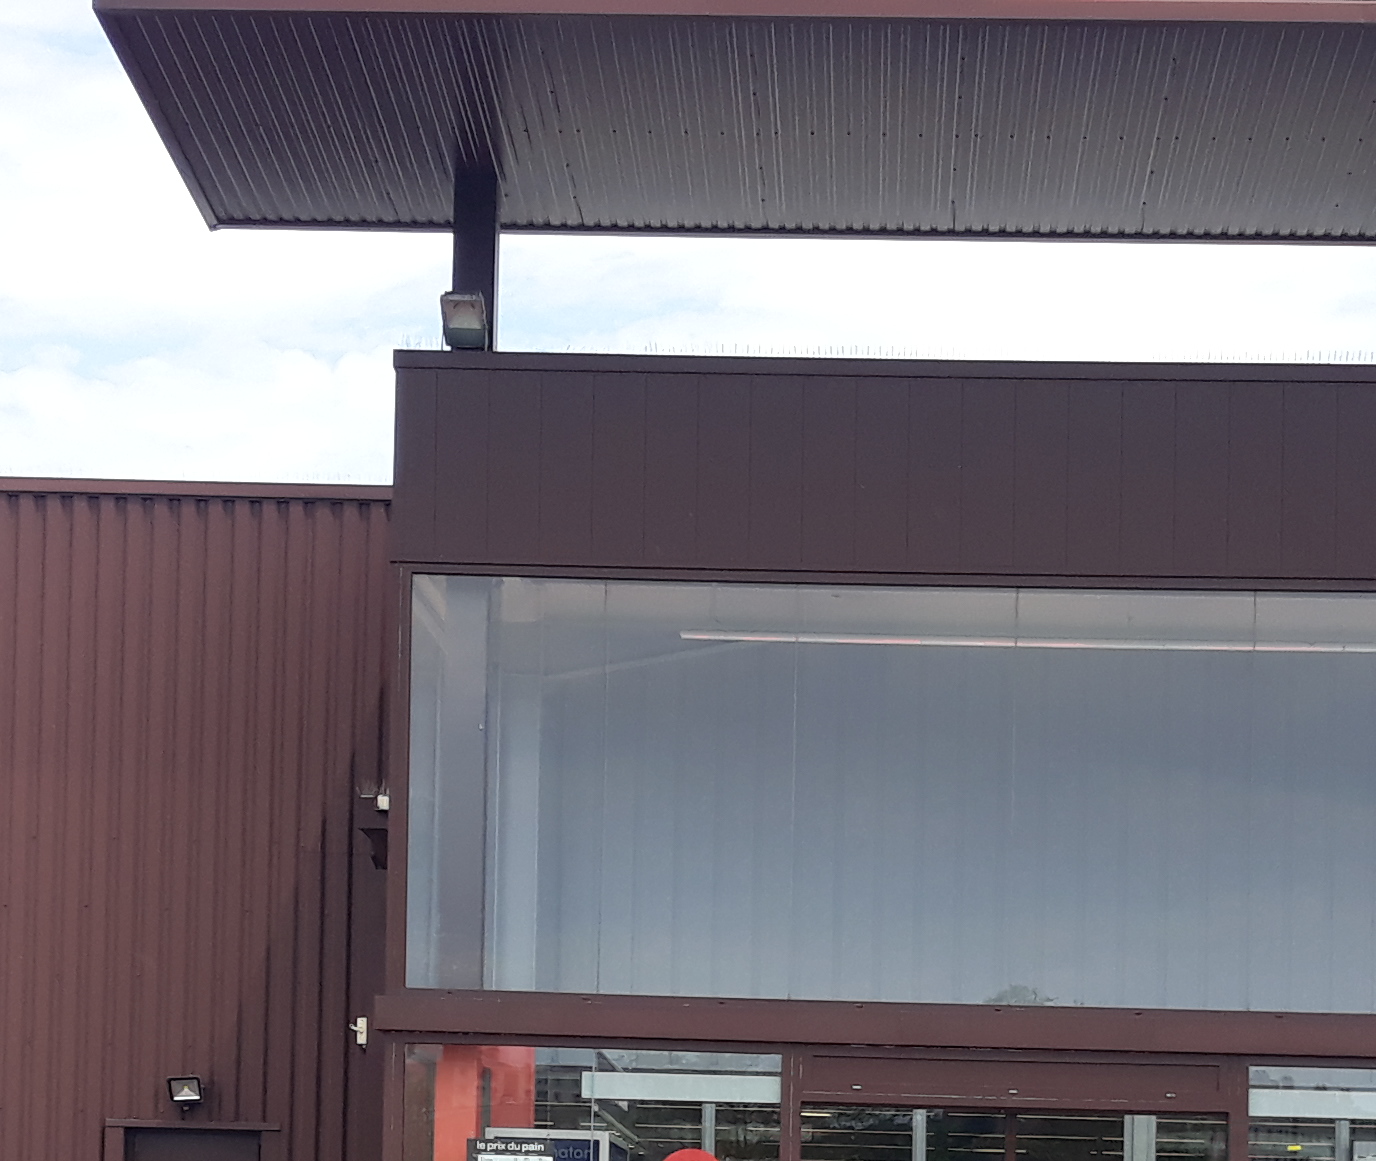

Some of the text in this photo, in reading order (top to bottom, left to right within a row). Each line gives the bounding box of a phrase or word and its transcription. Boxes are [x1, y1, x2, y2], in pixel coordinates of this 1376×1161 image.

[476, 1142, 545, 1152] le prix du pain
